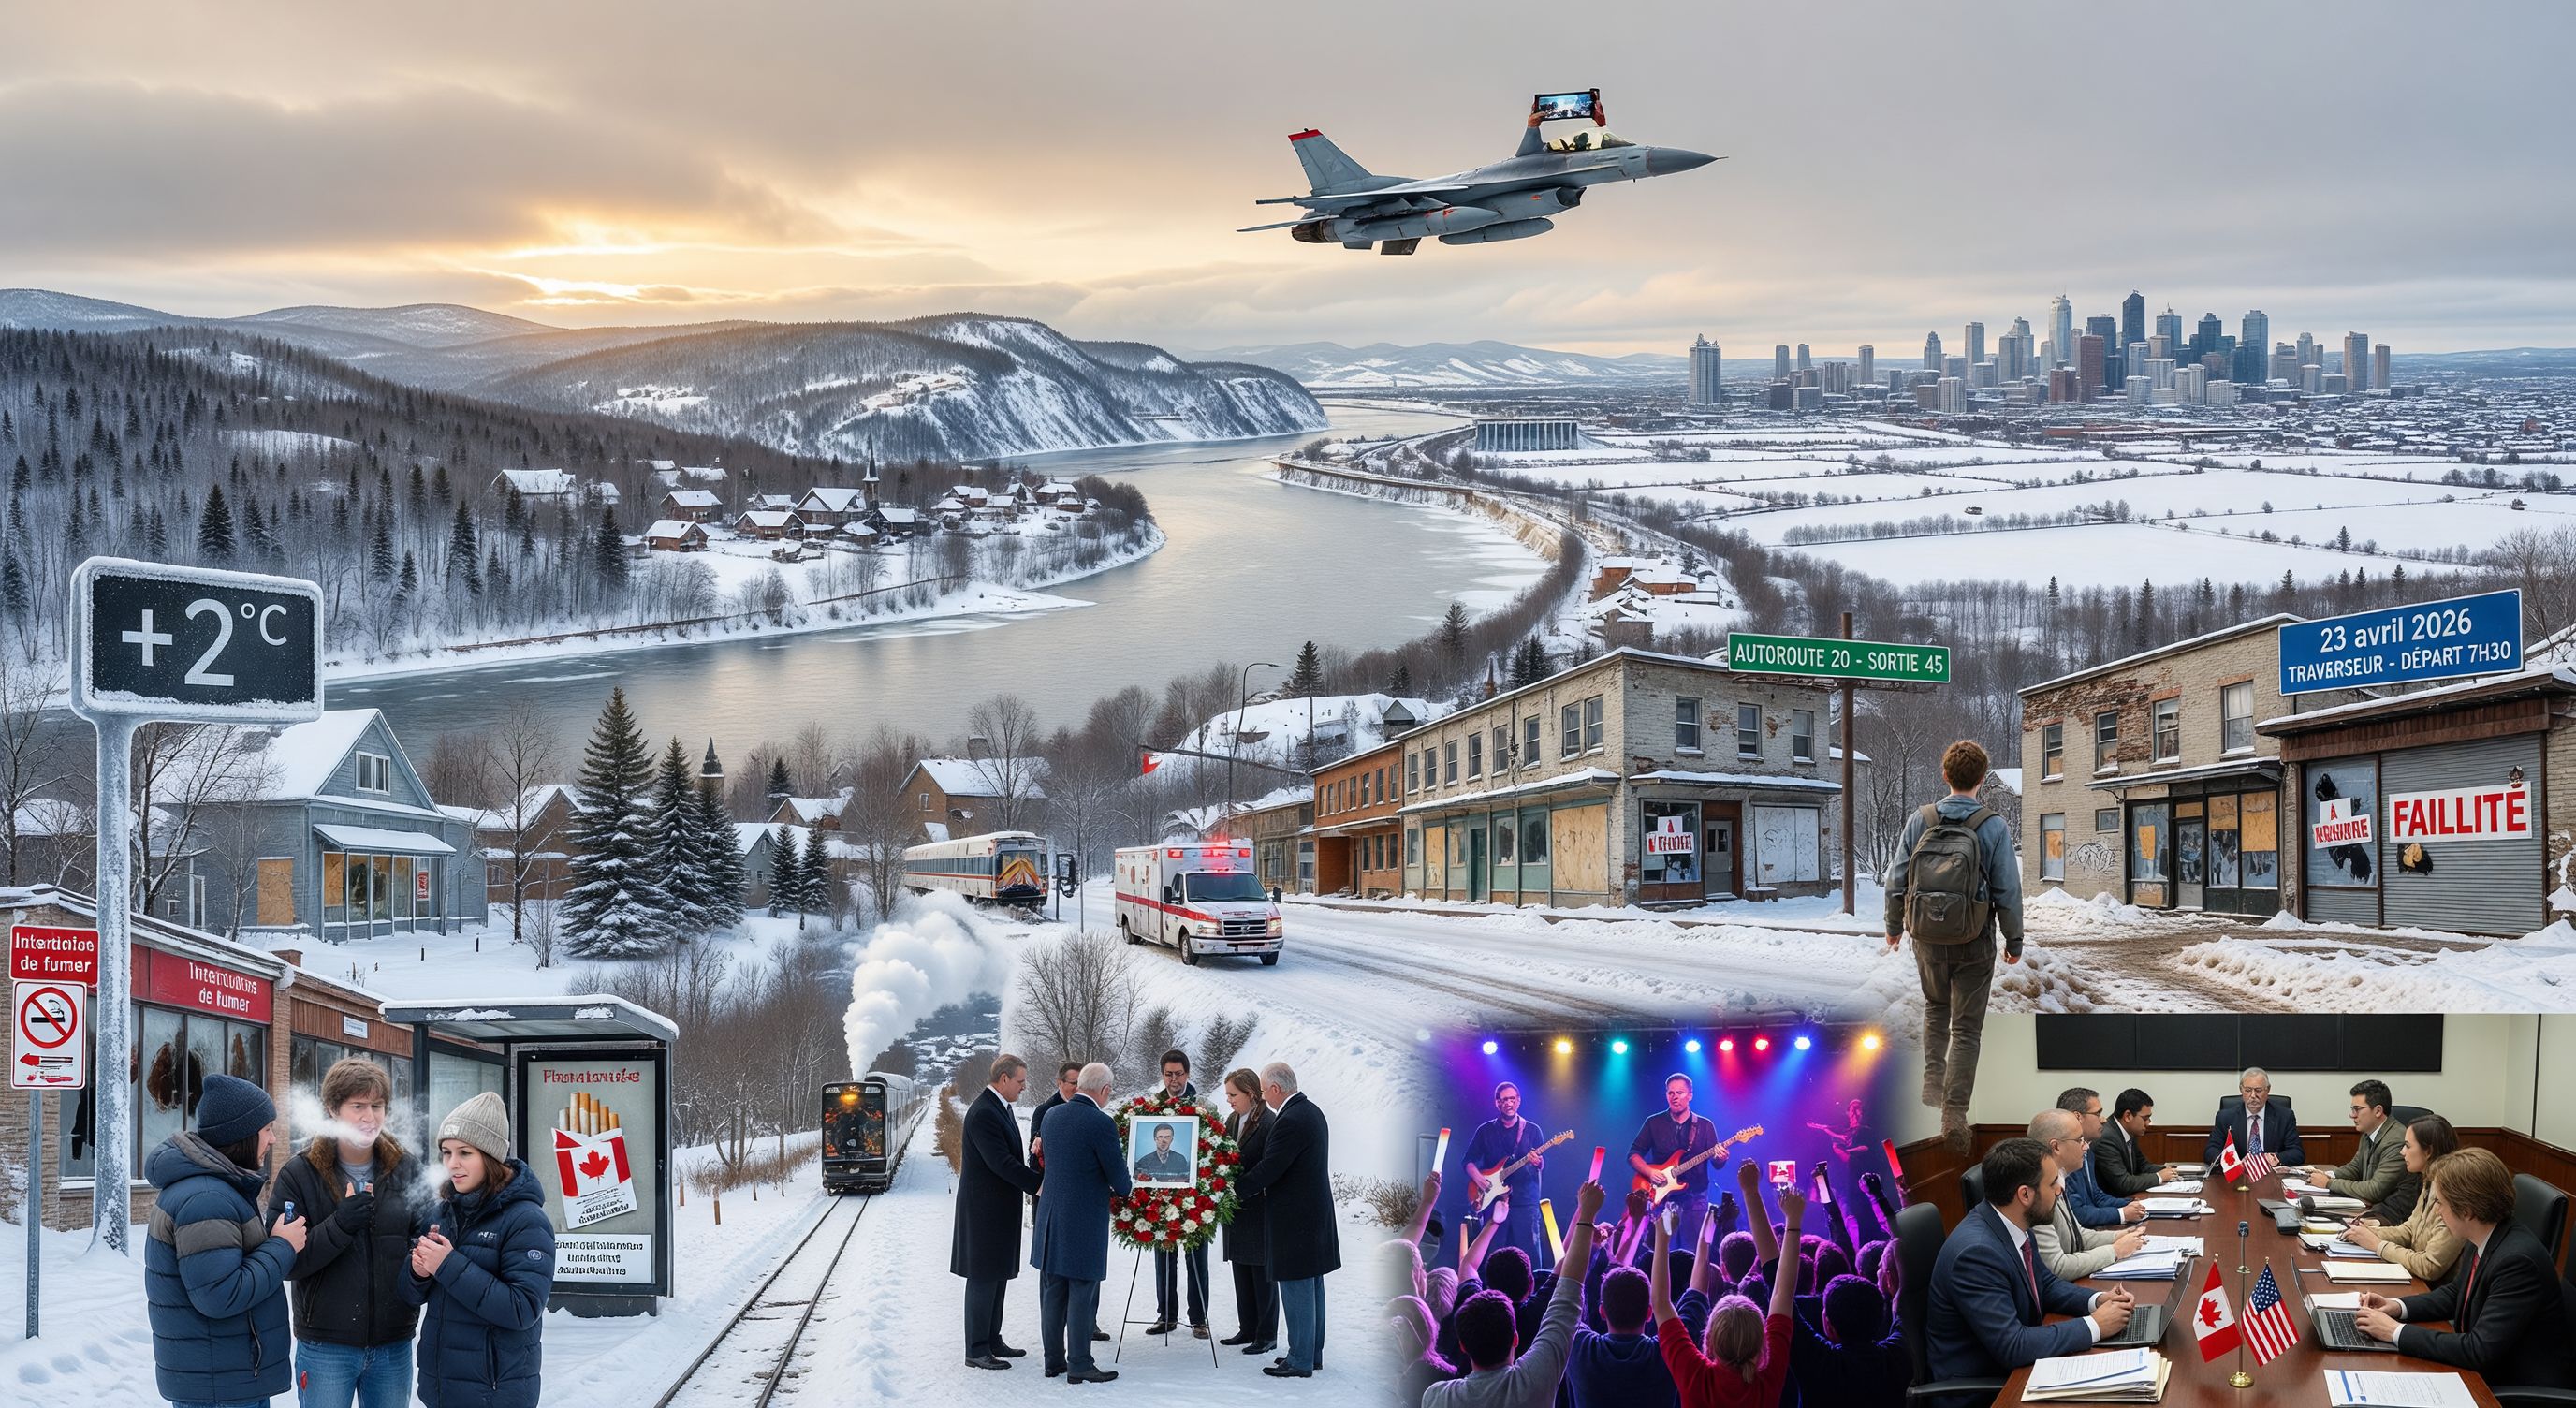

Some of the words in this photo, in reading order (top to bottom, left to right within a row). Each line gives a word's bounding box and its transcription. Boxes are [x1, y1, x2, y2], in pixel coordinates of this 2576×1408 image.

[2320, 626, 2347, 653] 23
[2354, 617, 2404, 649] avril
[2411, 608, 2472, 641] 2026
[1734, 644, 1825, 667] AUTOROUTE
[1831, 650, 1851, 668] 20
[1868, 652, 1919, 672] SORTIE
[1925, 655, 1943, 674] 45
[2288, 655, 2383, 683] TRAVERSEUR
[2401, 647, 2464, 670] DÉPART
[2467, 640, 2511, 663] 7H30
[20, 955, 38, 971] de
[44, 956, 92, 973] fumer
[198, 988, 212, 1005] de
